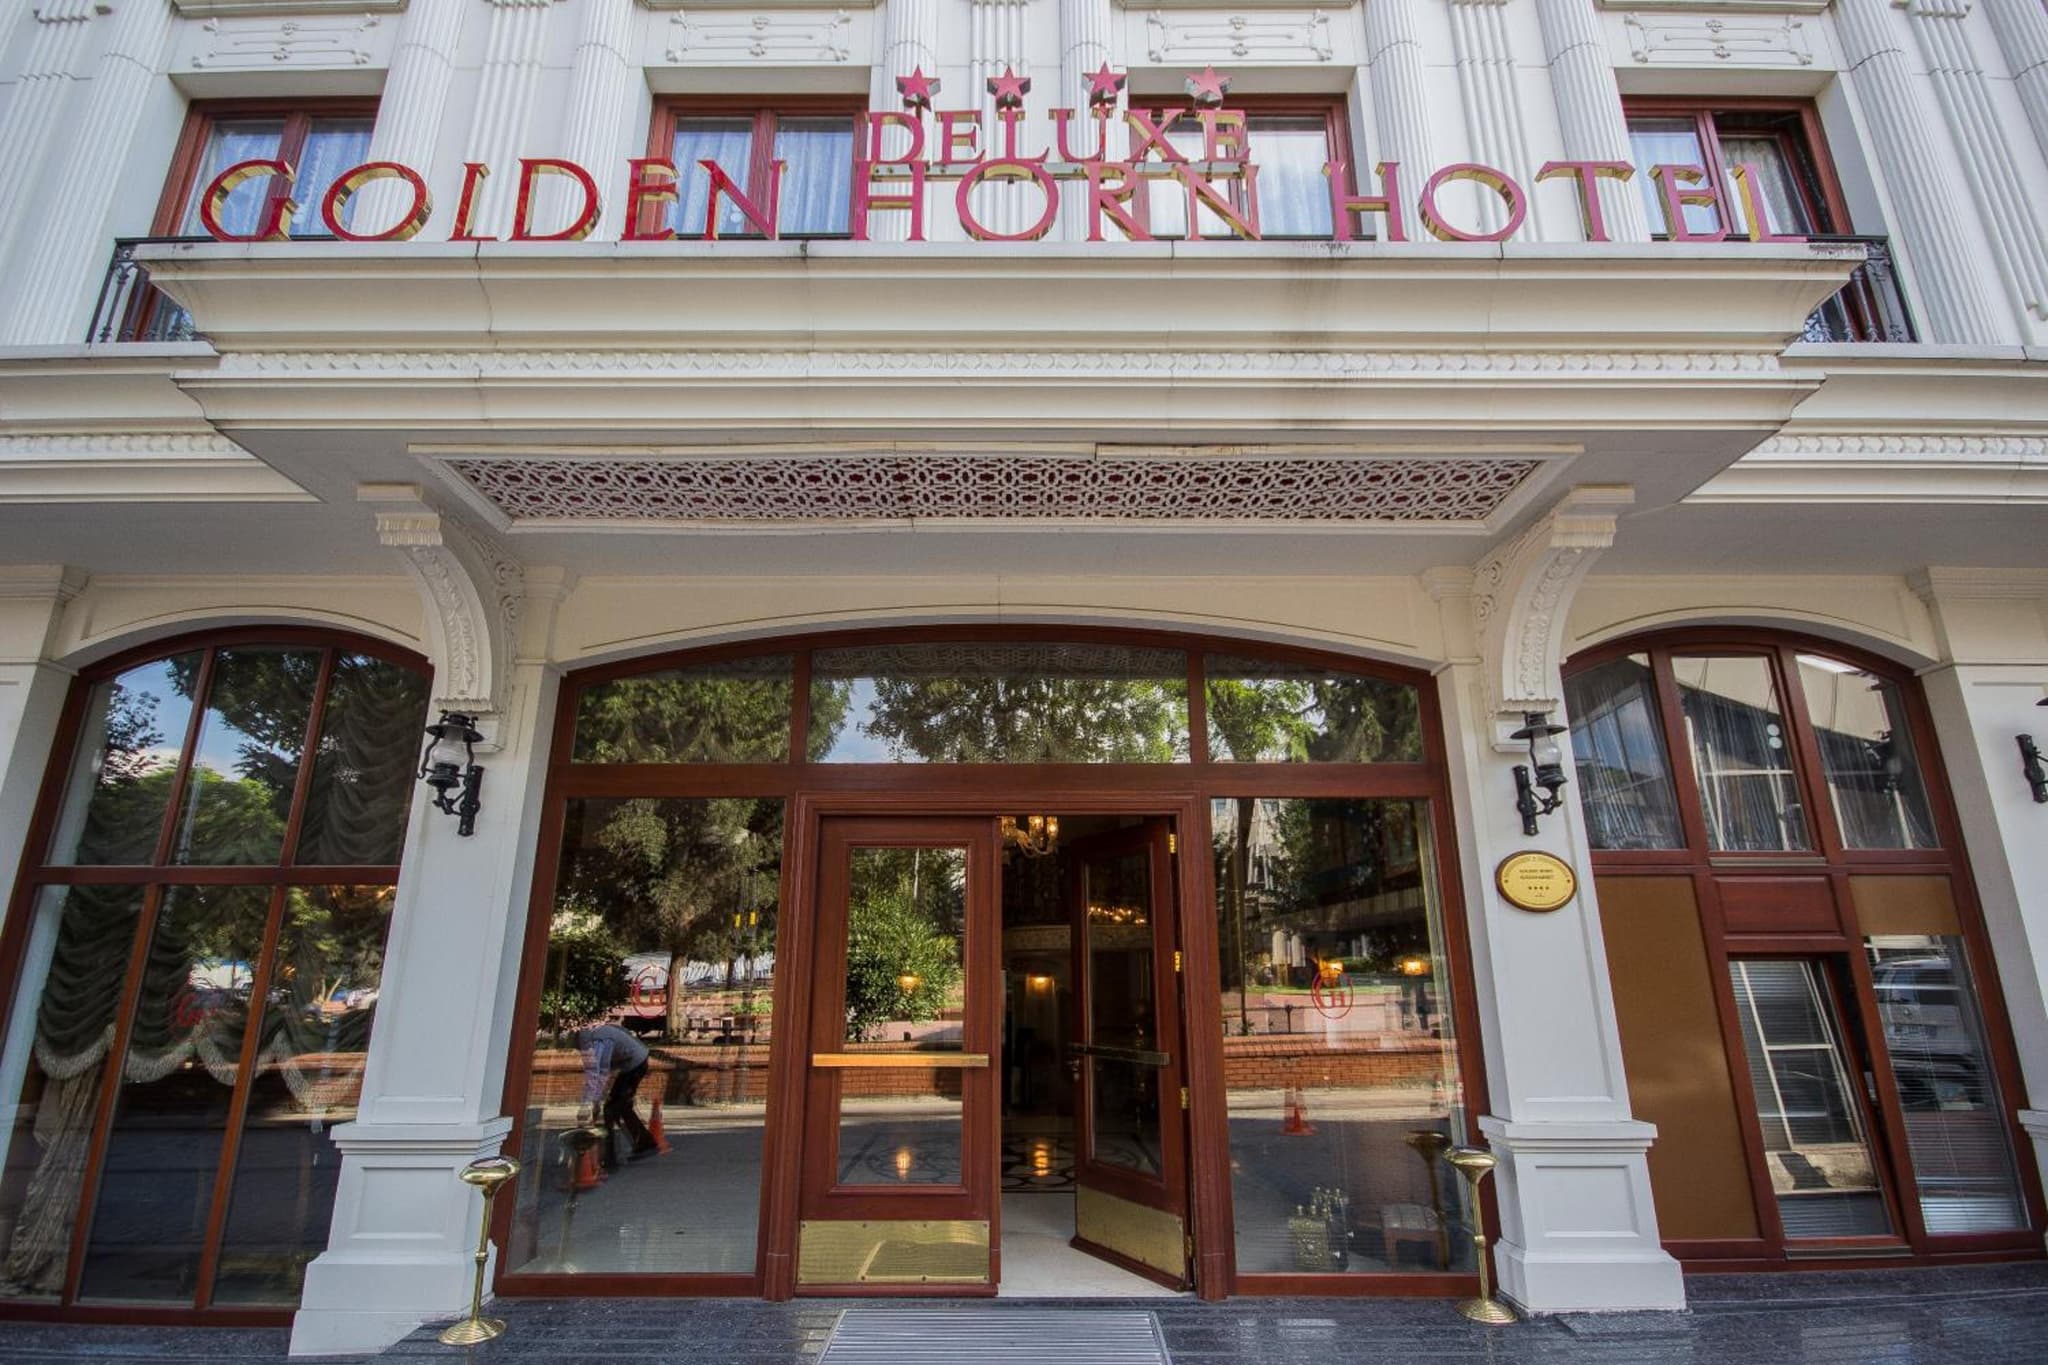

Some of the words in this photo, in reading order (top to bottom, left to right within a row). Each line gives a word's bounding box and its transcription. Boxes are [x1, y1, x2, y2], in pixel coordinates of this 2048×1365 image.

[864, 108, 1251, 163] DELUXE
[200, 158, 787, 242] GOLDEN
[852, 159, 1262, 242] HORN
[1322, 160, 1808, 242] HOTEL
